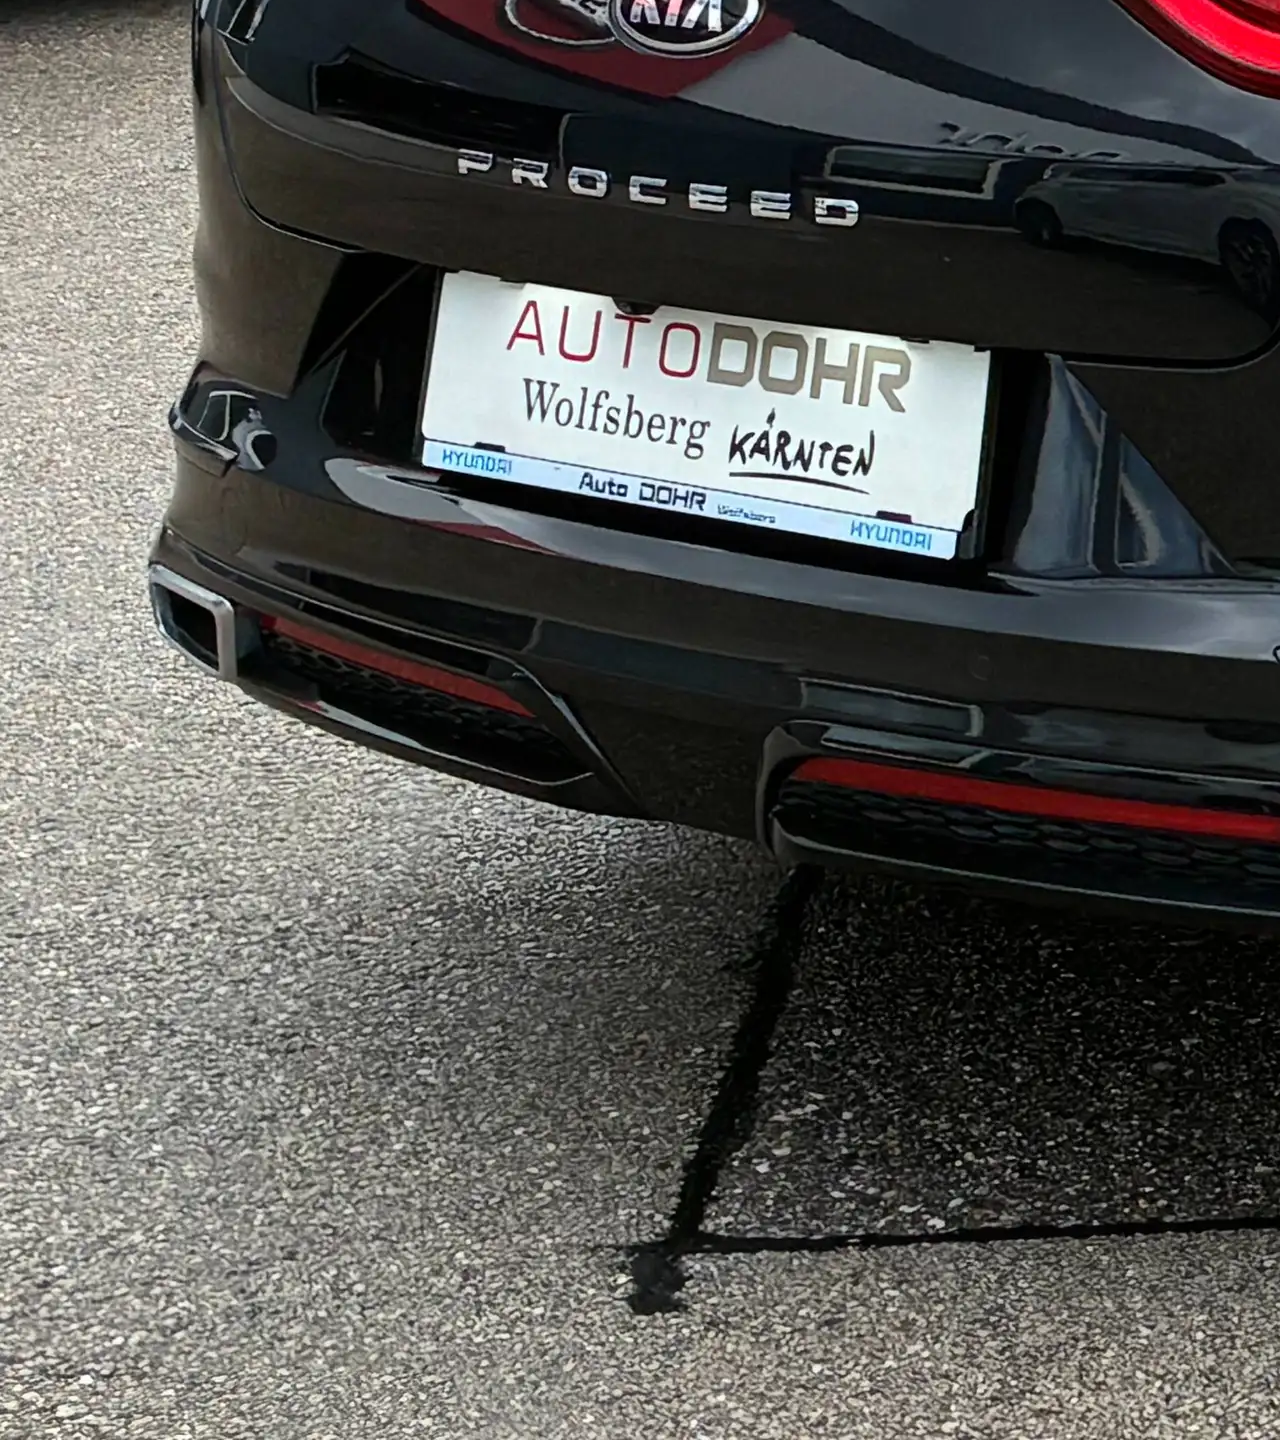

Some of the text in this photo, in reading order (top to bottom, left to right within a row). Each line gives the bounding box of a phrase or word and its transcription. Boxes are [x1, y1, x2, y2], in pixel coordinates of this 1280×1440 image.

[457, 148, 860, 228] PROCEED
[522, 377, 711, 460] Wolfsberg
[441, 448, 513, 475] HYUNDAI
[578, 471, 629, 498] Auto
[638, 481, 707, 512] DOHR
[849, 519, 933, 551] HYUNDAI
